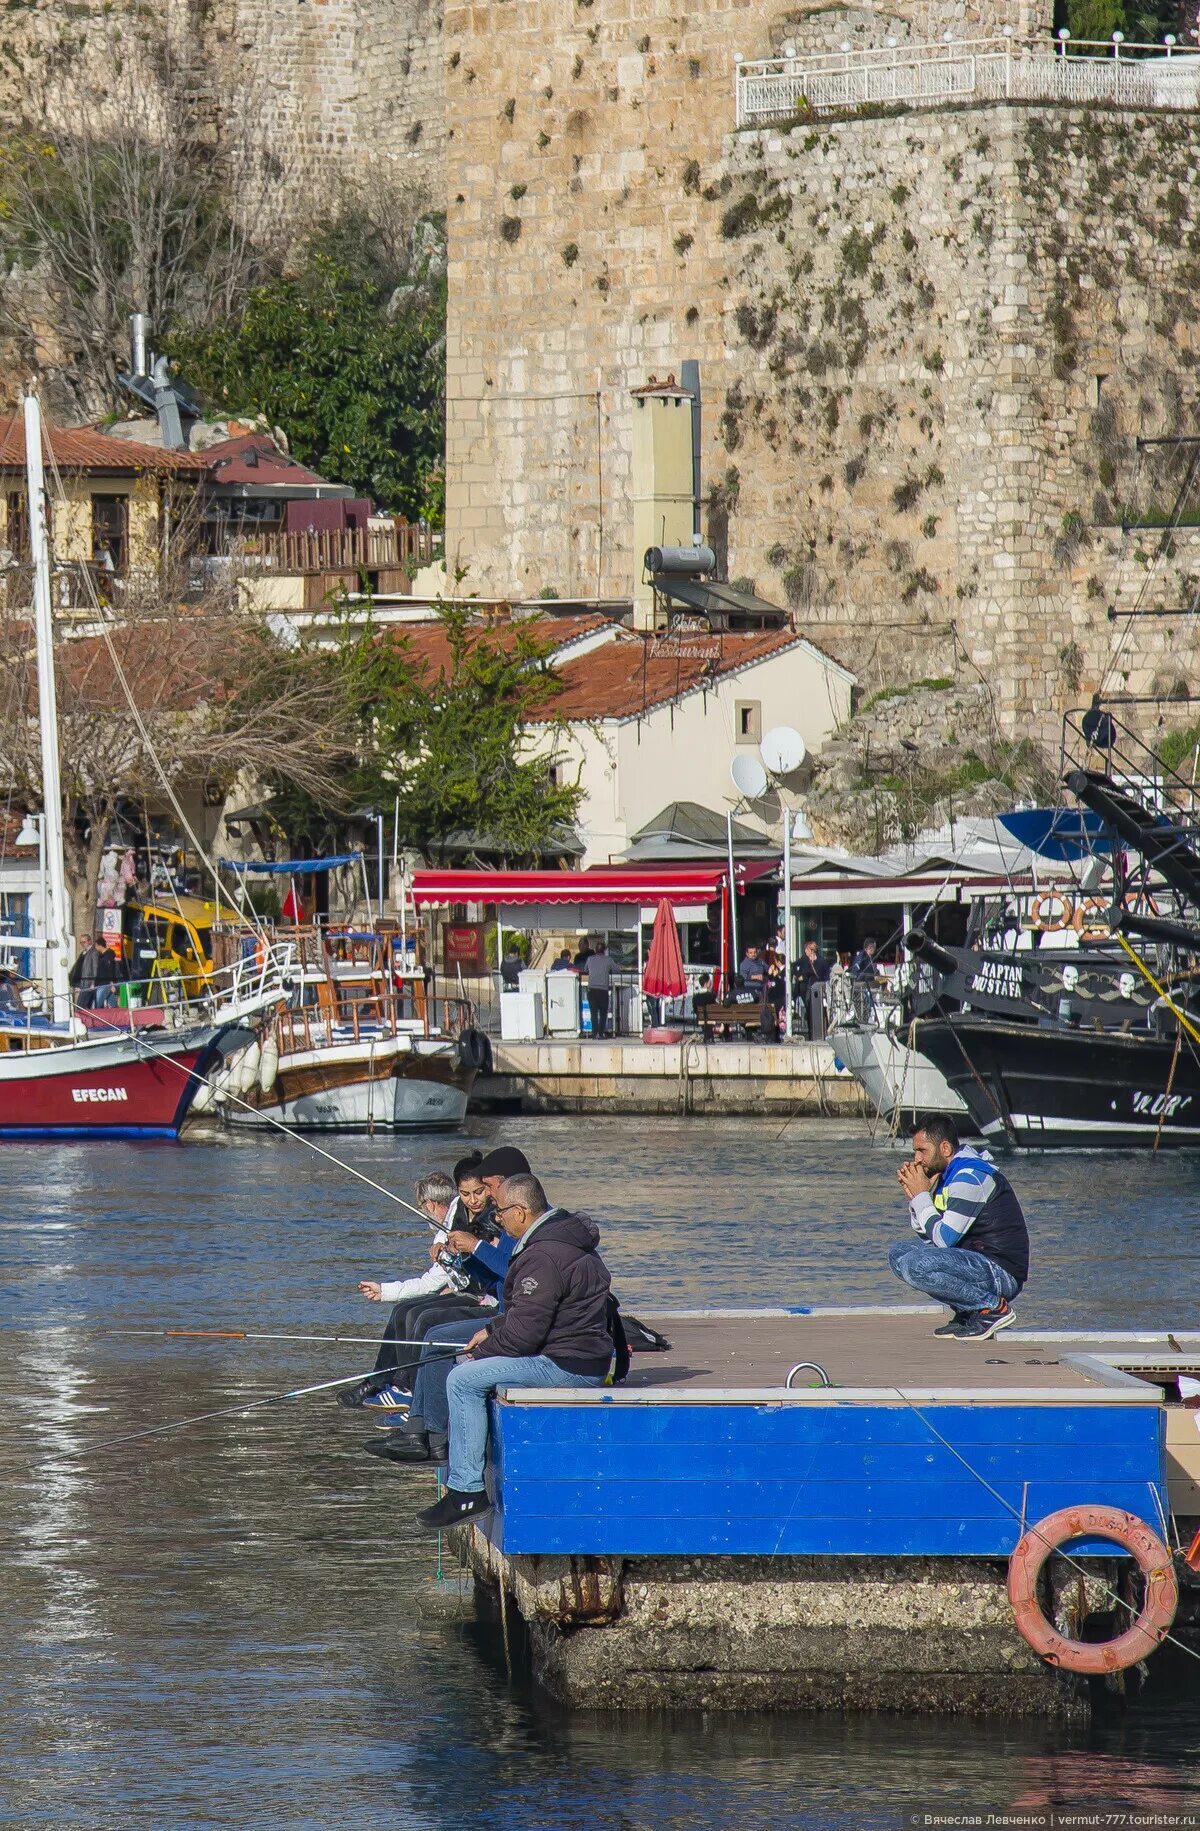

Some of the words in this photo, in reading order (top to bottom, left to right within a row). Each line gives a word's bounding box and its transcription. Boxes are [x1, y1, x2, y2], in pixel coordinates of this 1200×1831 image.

[981, 961, 1023, 982] KAPTAN
[971, 974, 1022, 998] MUSTAFA
[71, 1087, 129, 1103] EFECAN
